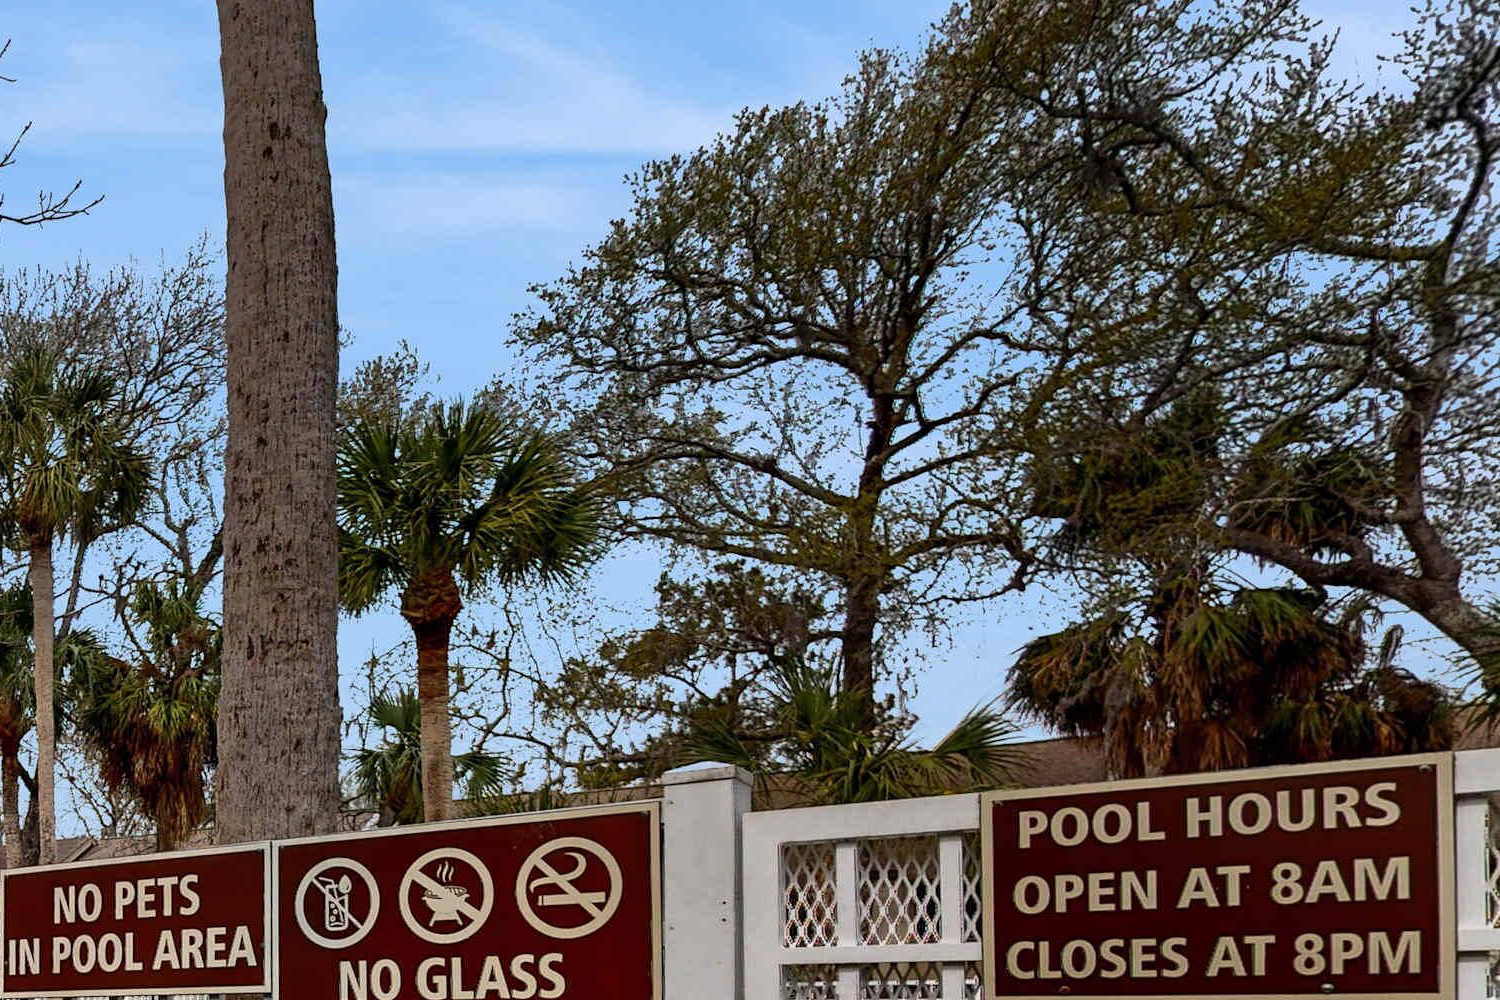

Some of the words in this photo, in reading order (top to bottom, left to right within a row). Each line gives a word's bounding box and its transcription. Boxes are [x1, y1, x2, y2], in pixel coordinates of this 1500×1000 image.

[1020, 802, 1164, 848] POOL
[1187, 783, 1399, 837] HOURS
[54, 884, 102, 923] NO
[116, 875, 199, 919] PETS
[1015, 871, 1156, 913] OPEN
[1178, 866, 1250, 907] AT
[1272, 857, 1409, 904] 8AM
[9, 938, 39, 975] IN
[53, 933, 142, 973] POOL
[153, 926, 256, 969] AREA
[1008, 938, 1188, 978] CLOSES
[1207, 936, 1275, 976] AT
[1295, 931, 1420, 975] 8PM
[340, 959, 400, 1000] NO
[417, 953, 565, 1000] GLASS
